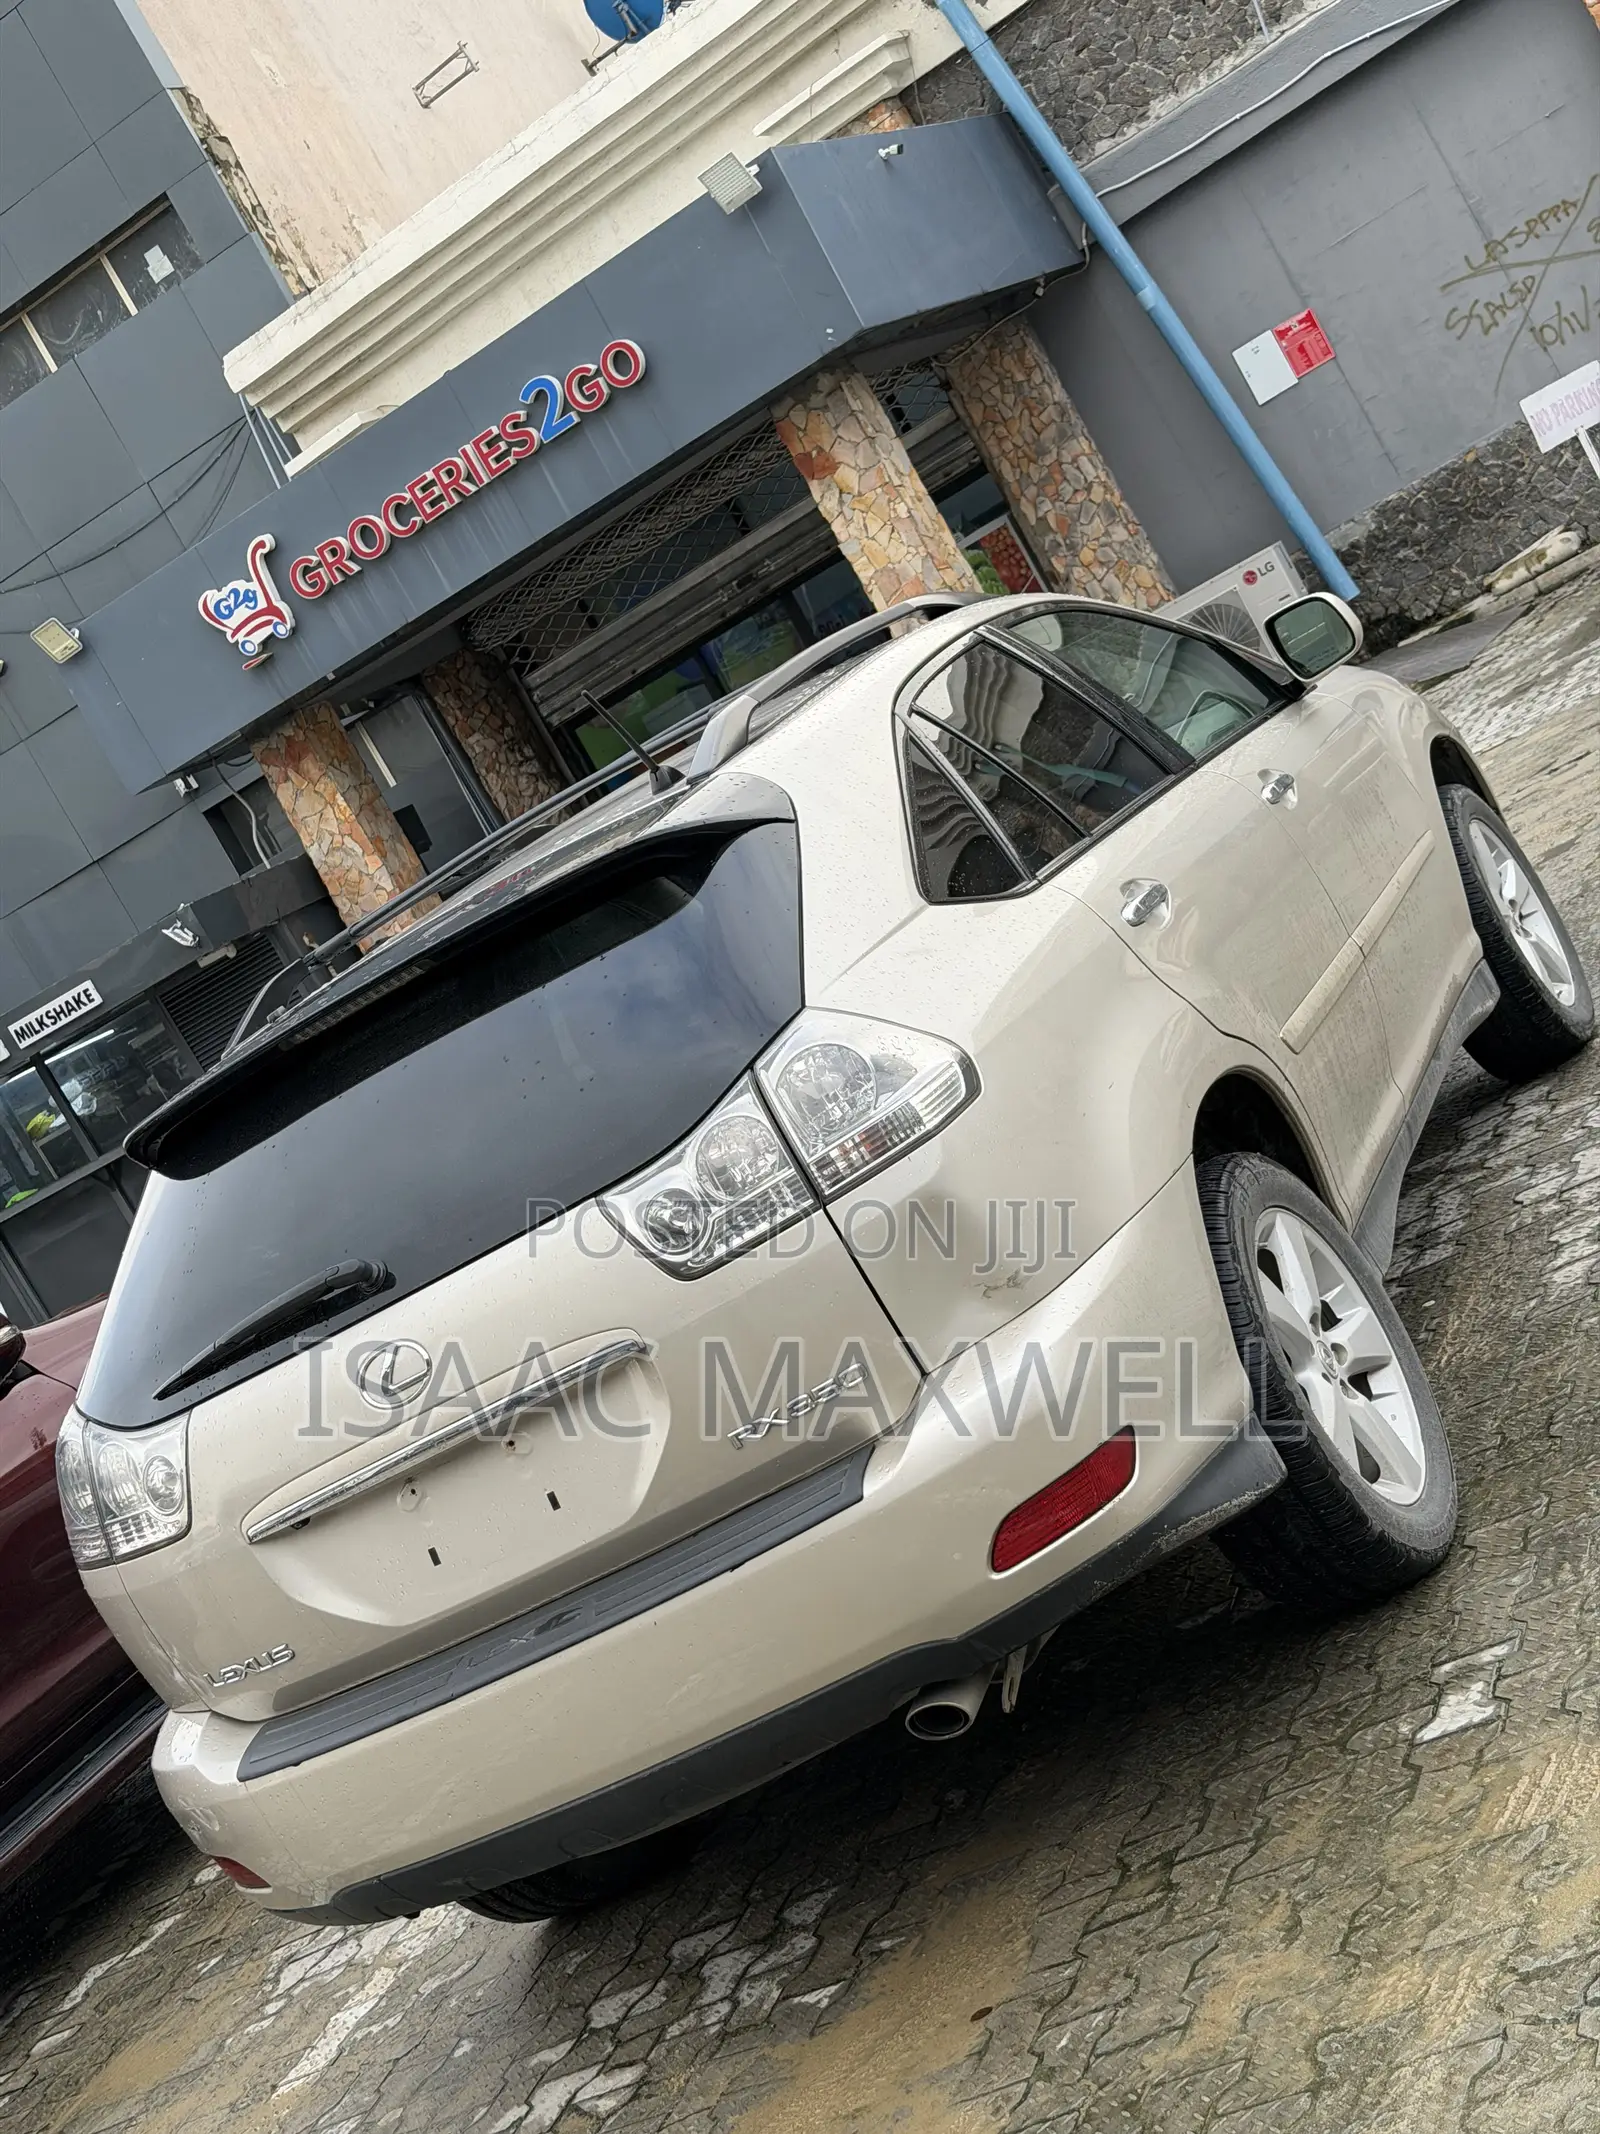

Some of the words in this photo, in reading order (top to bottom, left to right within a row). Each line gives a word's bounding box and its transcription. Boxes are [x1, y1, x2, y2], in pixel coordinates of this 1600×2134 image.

[288, 338, 647, 600] GROCERIES2GO
[1257, 561, 1275, 577] LG
[213, 587, 259, 621] G2g
[13, 988, 96, 1045] MILKSHAKE
[727, 1407, 791, 1450] RX
[786, 1362, 869, 1418] 350
[203, 1643, 295, 1688] LEXUS
